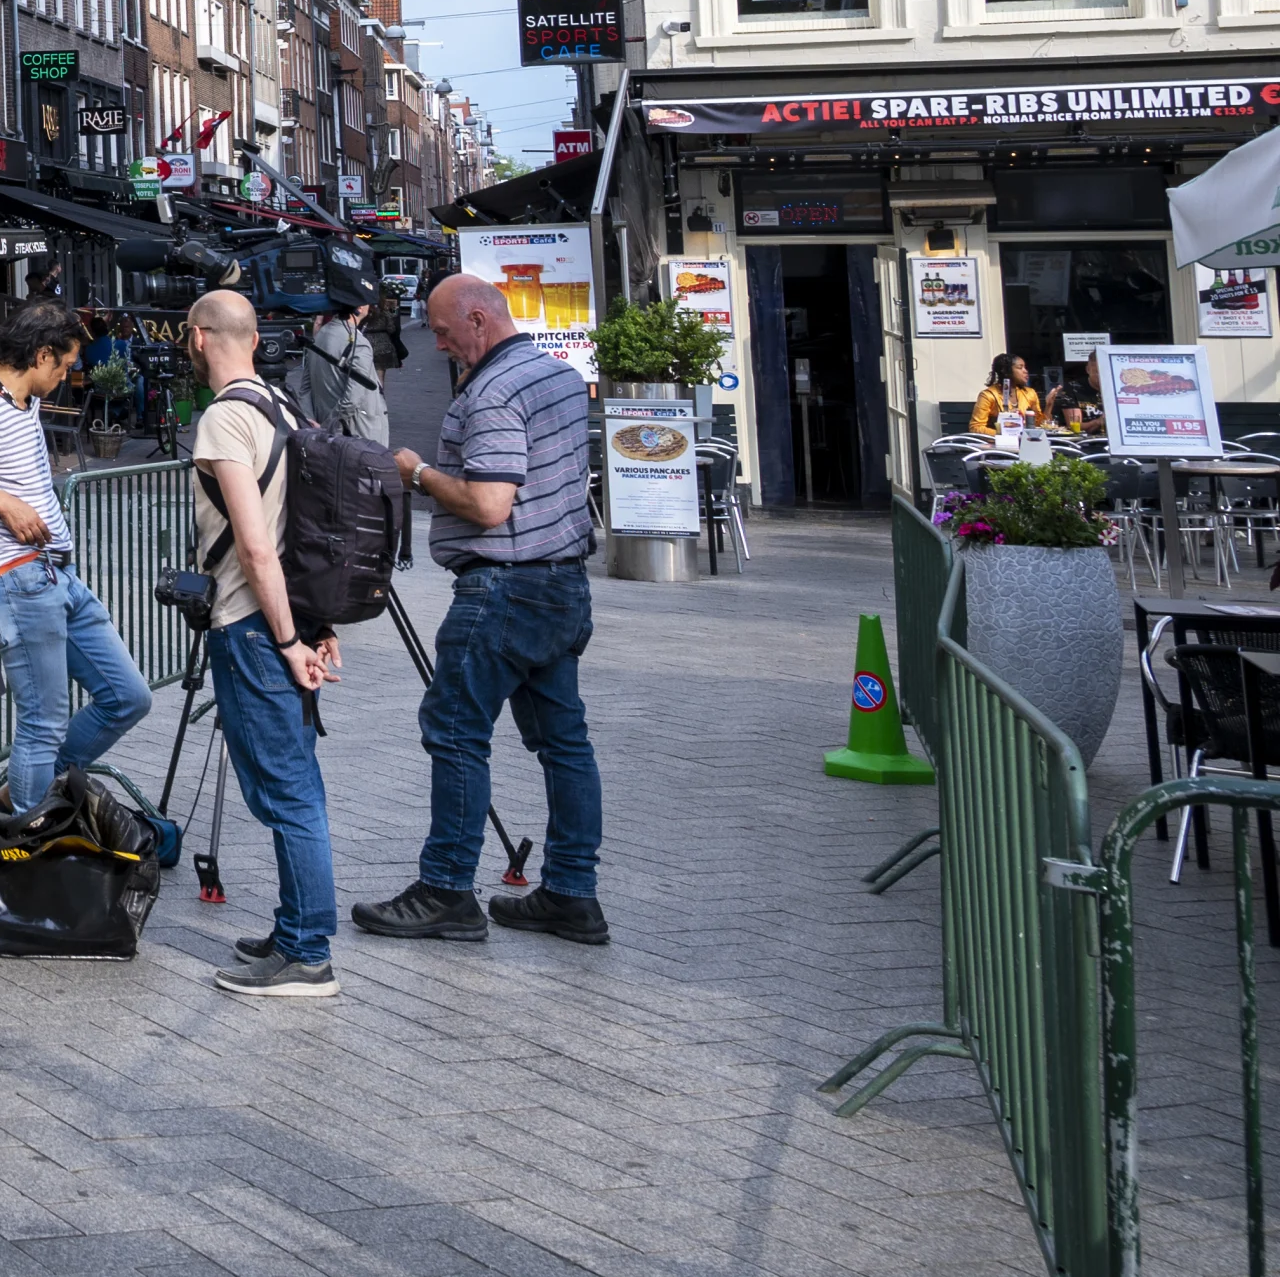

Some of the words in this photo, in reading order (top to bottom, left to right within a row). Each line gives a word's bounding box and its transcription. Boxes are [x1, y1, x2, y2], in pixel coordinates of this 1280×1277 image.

[526, 12, 617, 29] SATELLITE
[526, 26, 620, 46] SPORTS
[540, 43, 602, 61] CAFE
[23, 53, 76, 66] COFFEE
[30, 67, 69, 80] SHOP
[761, 100, 861, 122] ACTIE!
[871, 92, 1058, 119] SPARE-RIBS
[1067, 85, 1251, 111] UNLIMITED
[860, 120, 880, 129] ALL
[883, 119, 907, 128] YOU
[908, 118, 933, 127] CAN
[935, 117, 957, 127] EAT
[983, 113, 1036, 124] NORMAL
[1038, 112, 1074, 123] PRICE
[1076, 111, 1112, 121] FROM
[1114, 110, 1122, 119] 9
[1124, 109, 1146, 119] AM
[1147, 109, 1173, 118] TILL
[1174, 108, 1190, 118] 22
[1192, 107, 1212, 117] PM
[557, 142, 590, 154] ATM
[781, 207, 839, 221] OPEN
[714, 224, 723, 233] 11
[494, 238, 529, 246] SPORTS
[1210, 293, 1219, 301] 20
[537, 332, 585, 341] PITCHER
[536, 342, 564, 350] FROM
[649, 467, 691, 475] PANCAKES
